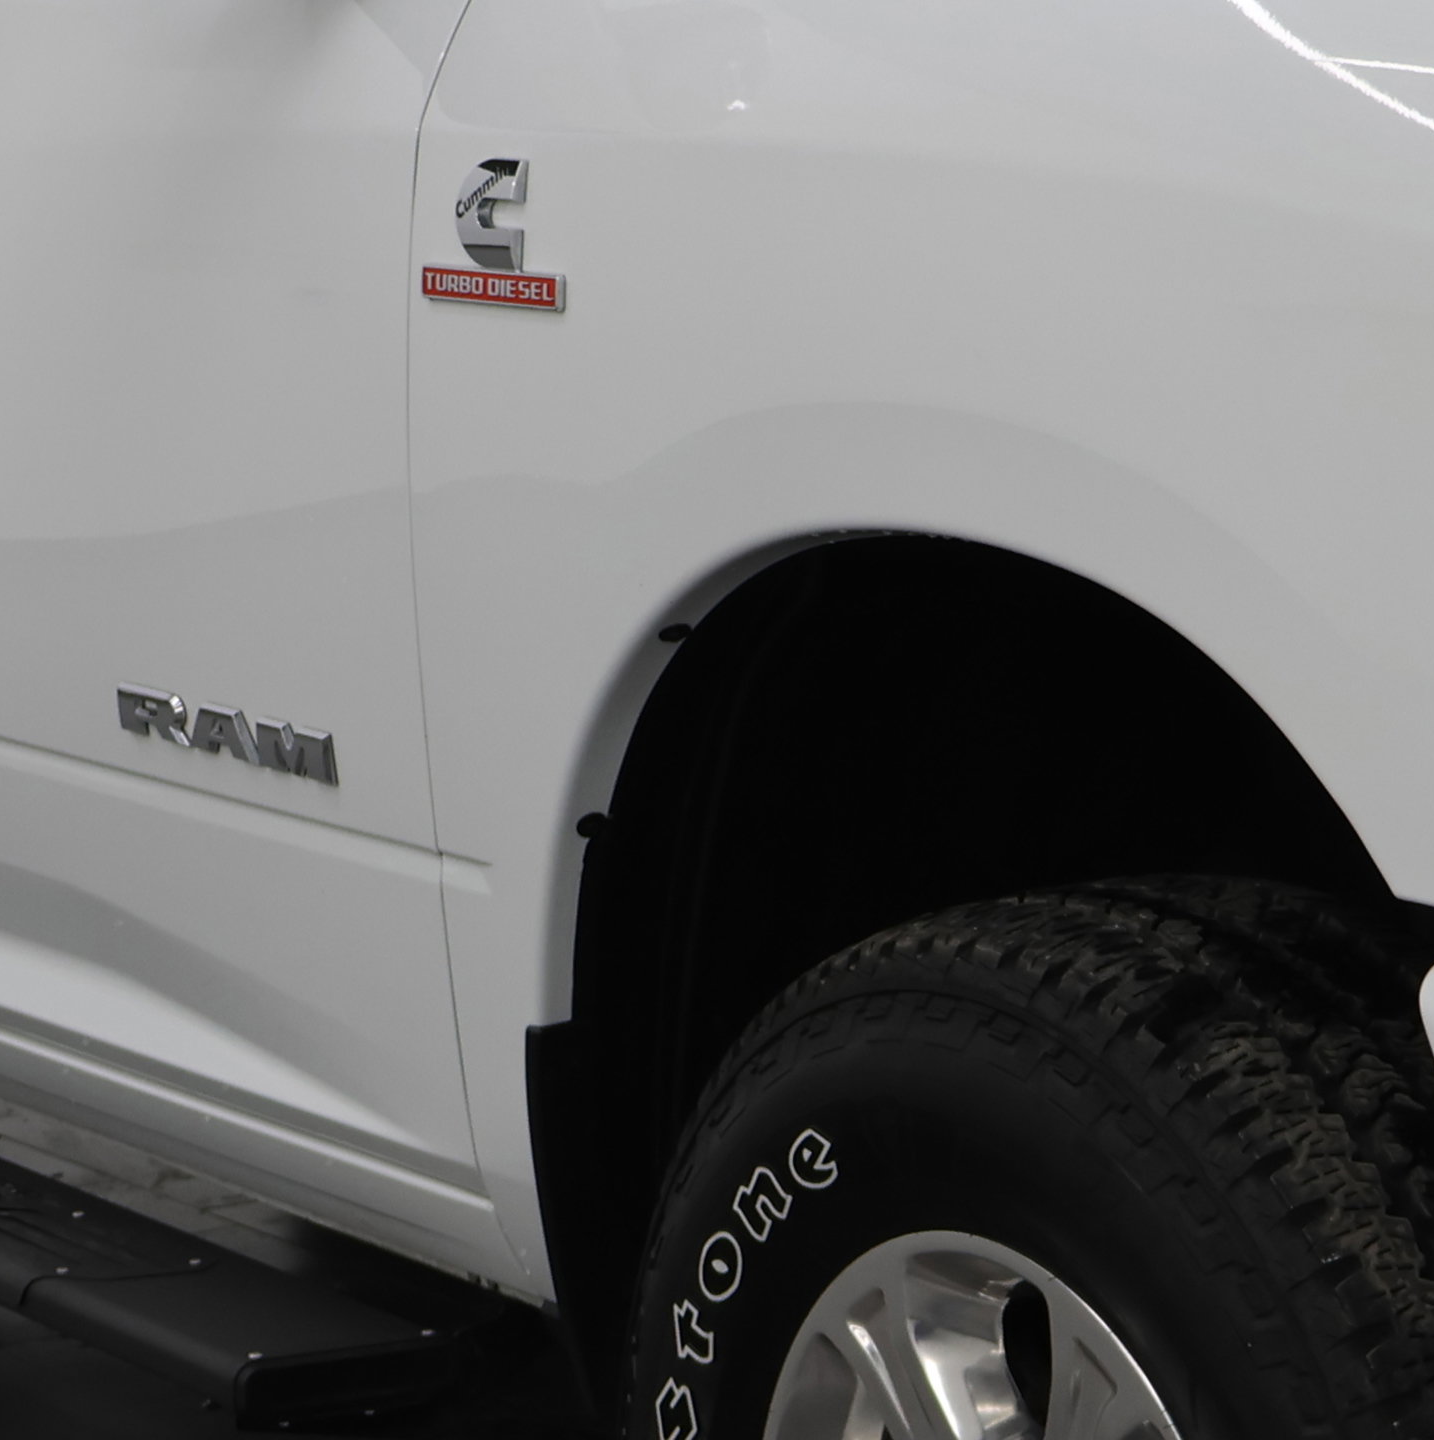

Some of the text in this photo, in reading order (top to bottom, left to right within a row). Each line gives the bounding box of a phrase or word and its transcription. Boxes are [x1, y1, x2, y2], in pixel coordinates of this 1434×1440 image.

[424, 270, 556, 302] TURBO DIESEL
[116, 680, 340, 788] RAM
